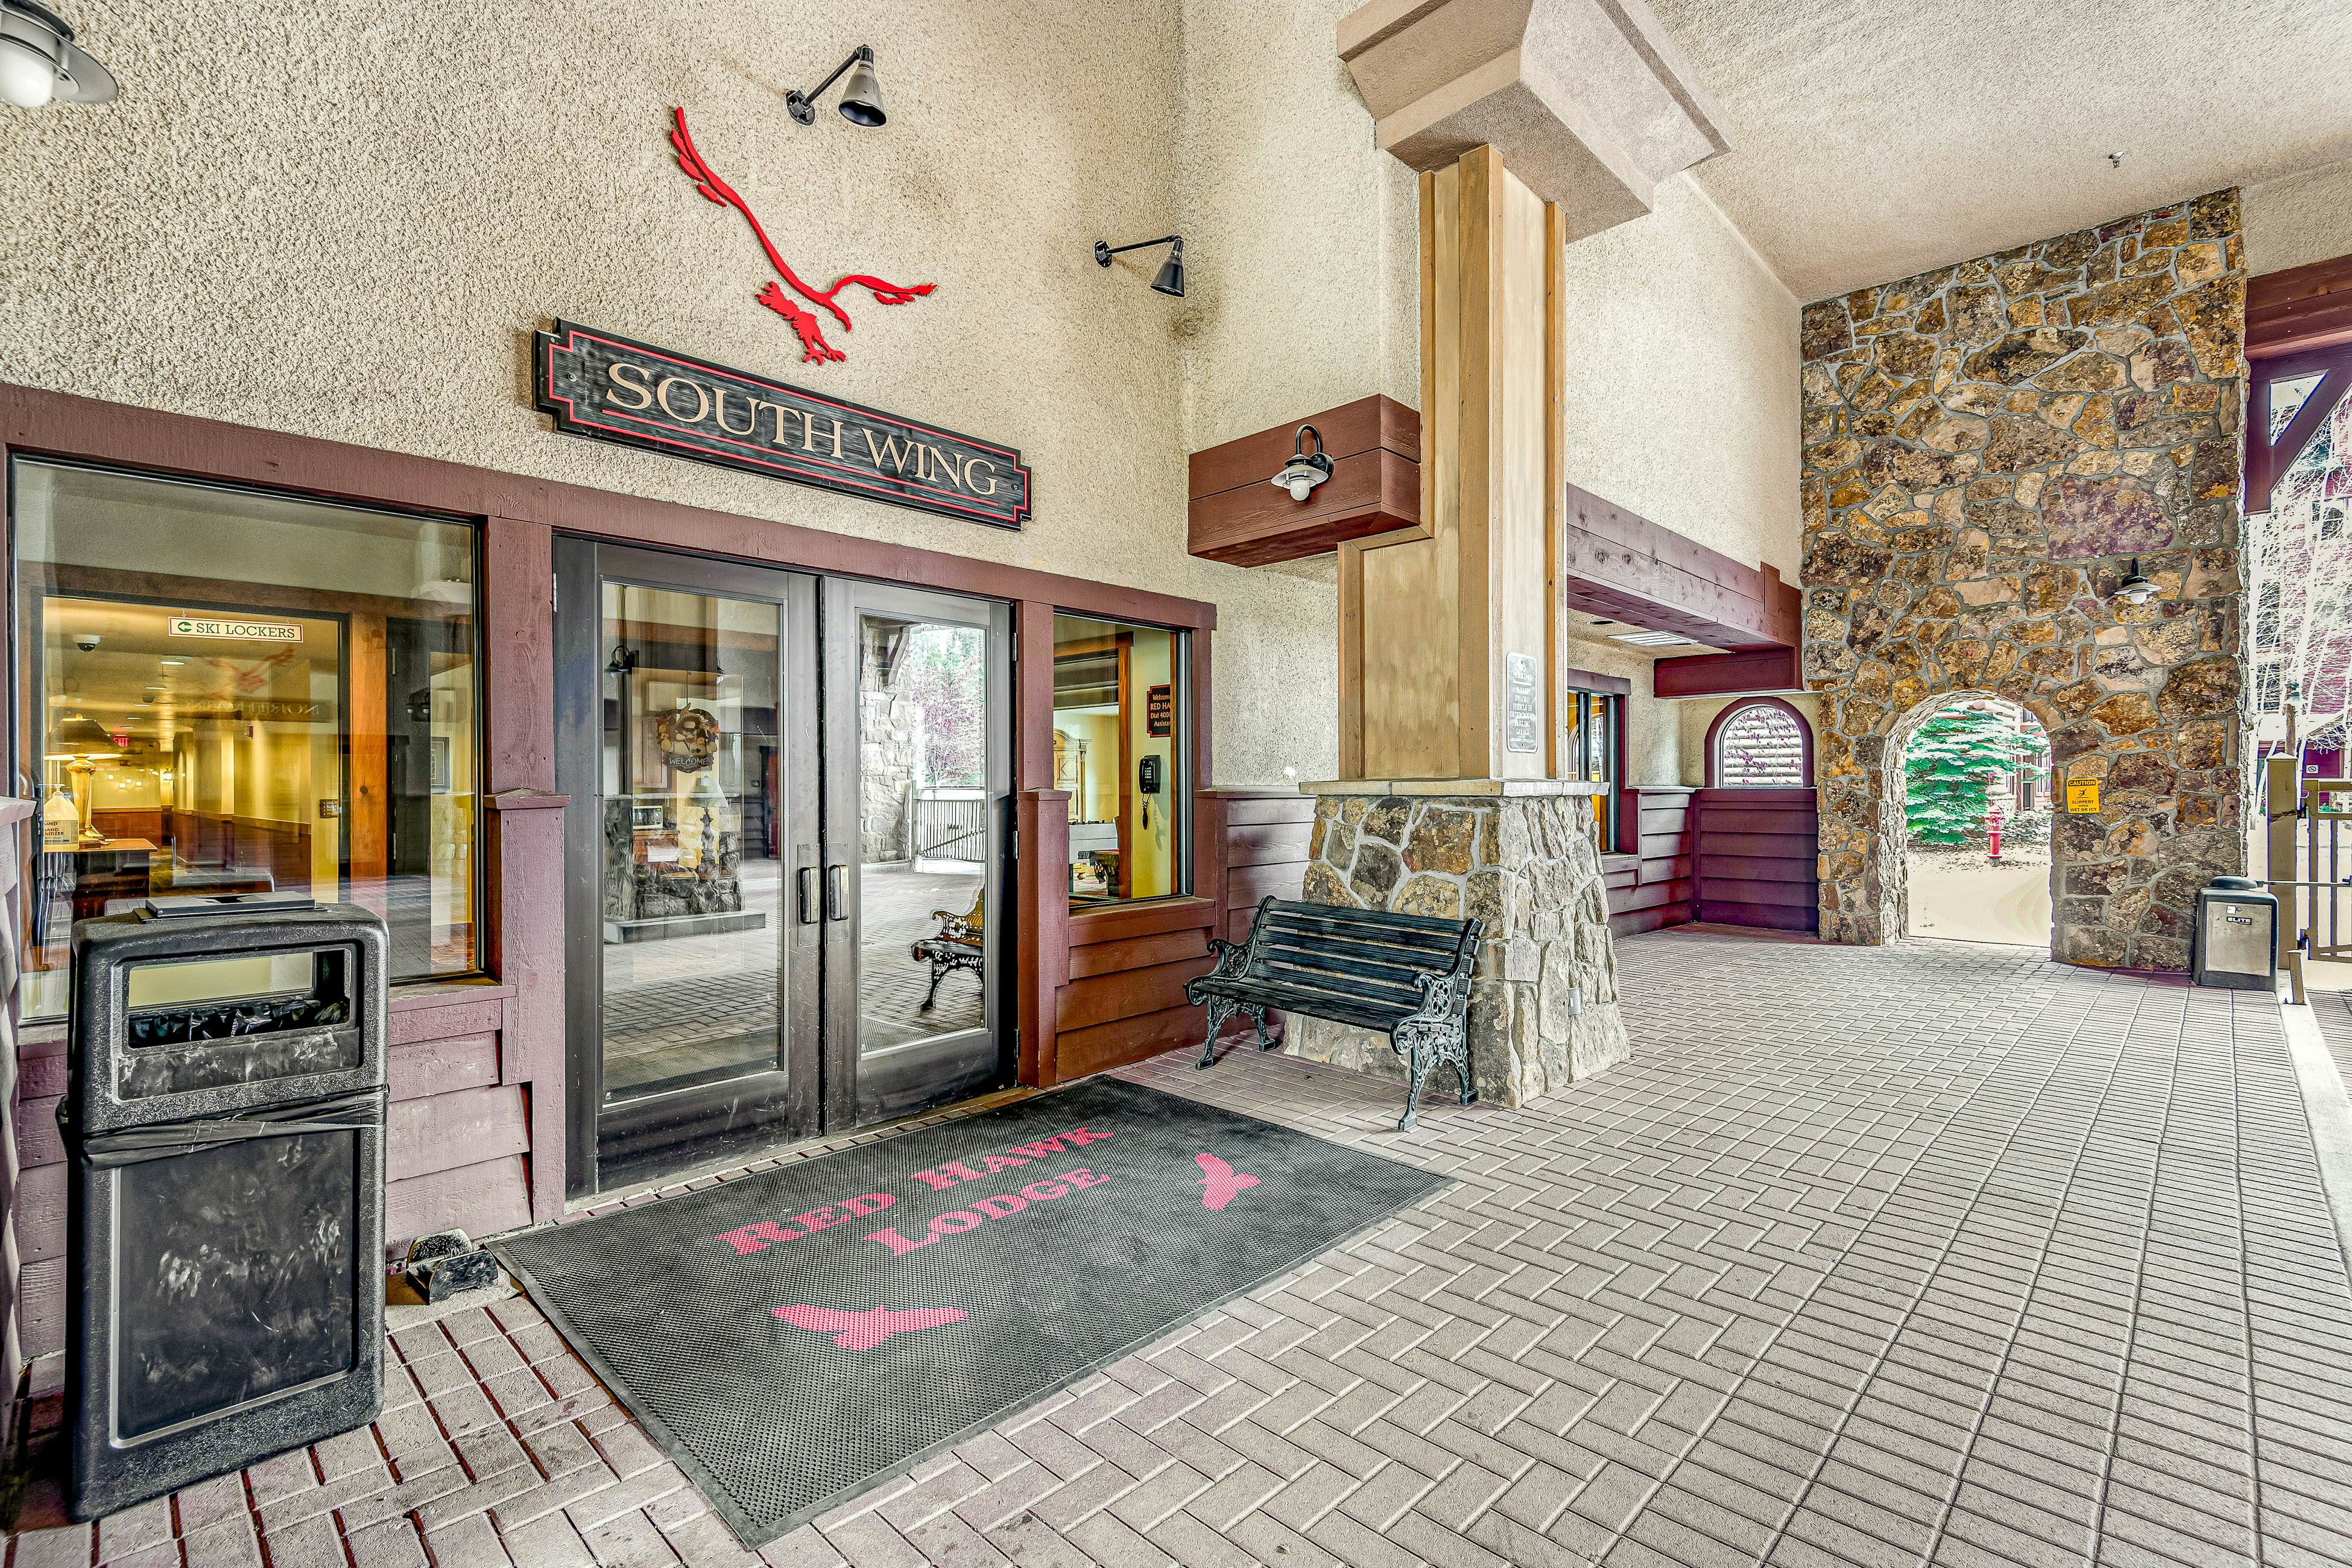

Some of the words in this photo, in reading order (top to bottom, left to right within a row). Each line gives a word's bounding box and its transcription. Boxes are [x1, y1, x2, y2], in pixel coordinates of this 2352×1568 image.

[606, 362, 846, 459] SOUTH
[861, 427, 998, 496] WING
[196, 623, 220, 634] SKI
[226, 624, 295, 638] LOCKERS
[669, 757, 708, 767] WELCOME
[714, 1192, 897, 1256] RED
[908, 1126, 1114, 1192] HAWK
[862, 1168, 1111, 1256] LODGE
